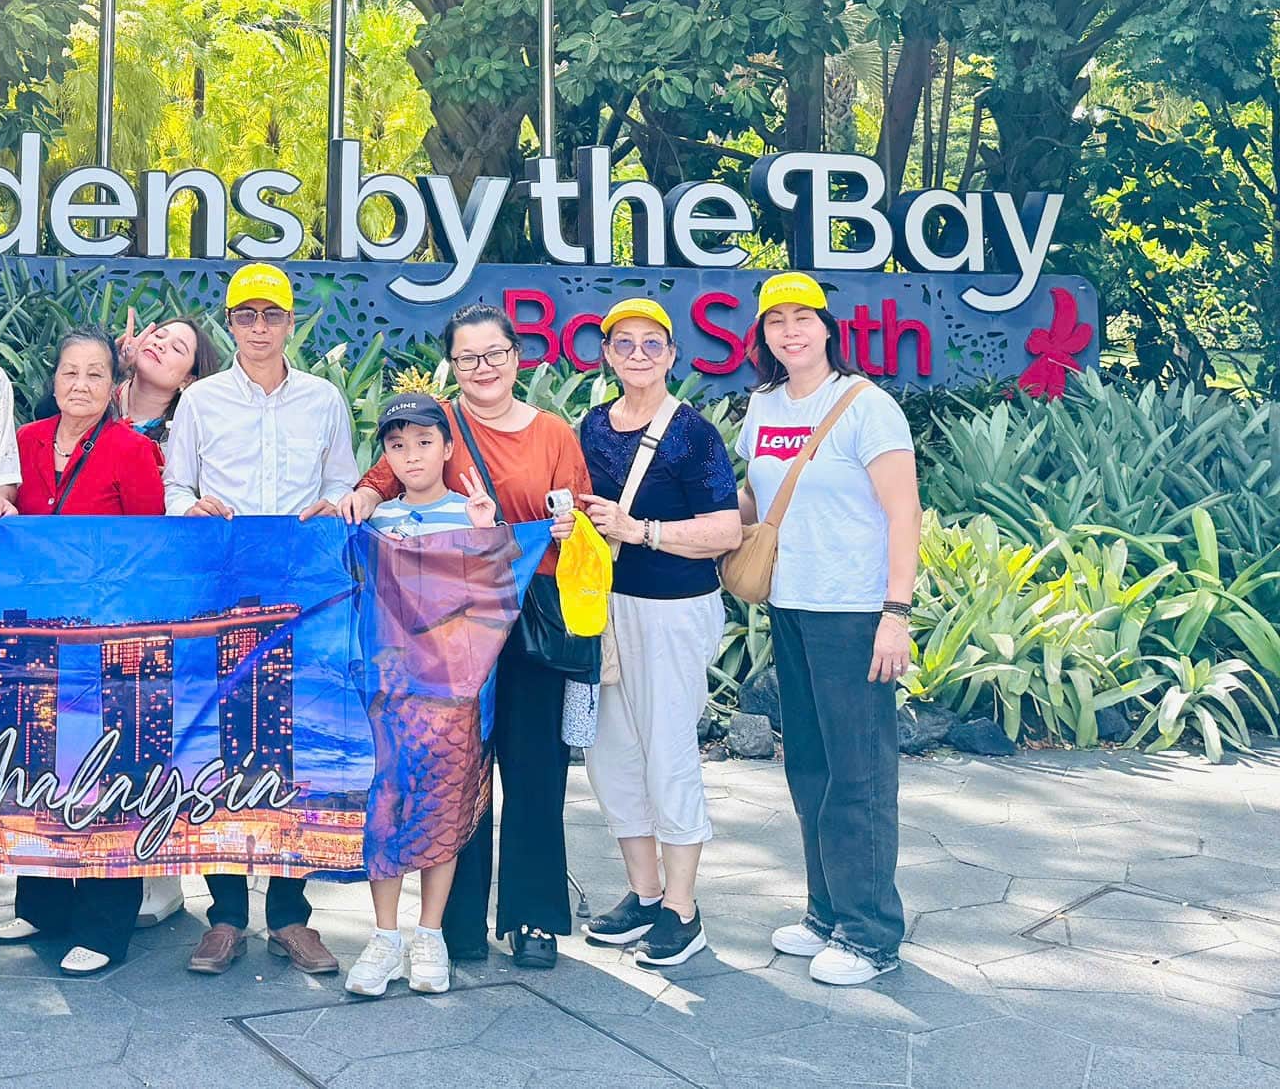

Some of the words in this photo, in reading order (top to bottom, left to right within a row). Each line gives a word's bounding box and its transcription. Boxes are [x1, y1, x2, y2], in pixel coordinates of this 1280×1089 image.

[332, 139, 511, 304] by
[530, 145, 751, 267] the
[760, 152, 1065, 311] Bay
[504, 289, 606, 373] Ba
[690, 292, 932, 375] Sth
[386, 402, 417, 416] CELINE
